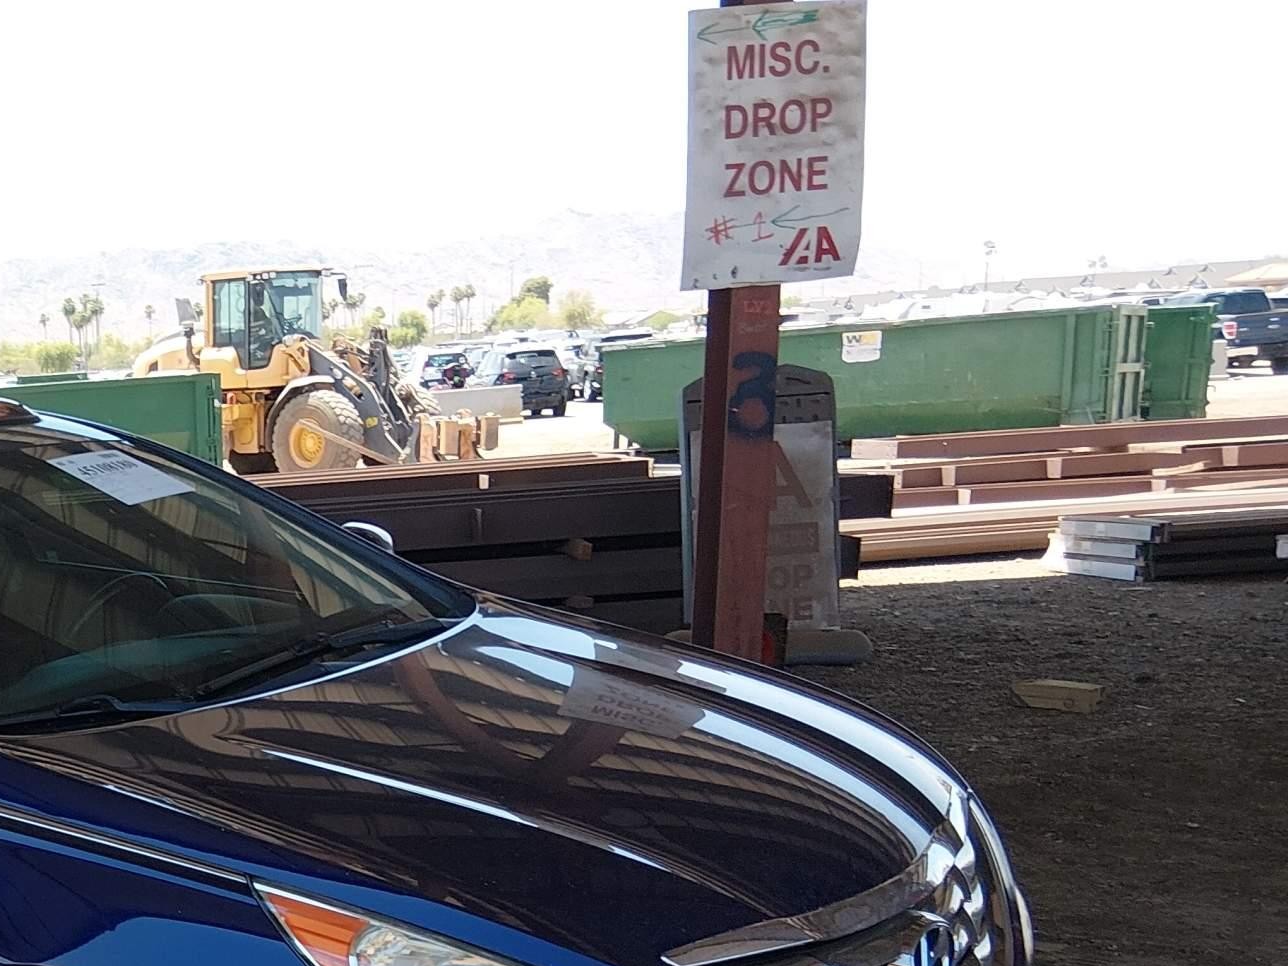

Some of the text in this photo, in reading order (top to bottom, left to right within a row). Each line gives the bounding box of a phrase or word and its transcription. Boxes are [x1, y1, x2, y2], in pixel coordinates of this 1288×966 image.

[726, 39, 831, 81] MISC.
[724, 97, 833, 140] DROP
[723, 155, 829, 199] ZONE
